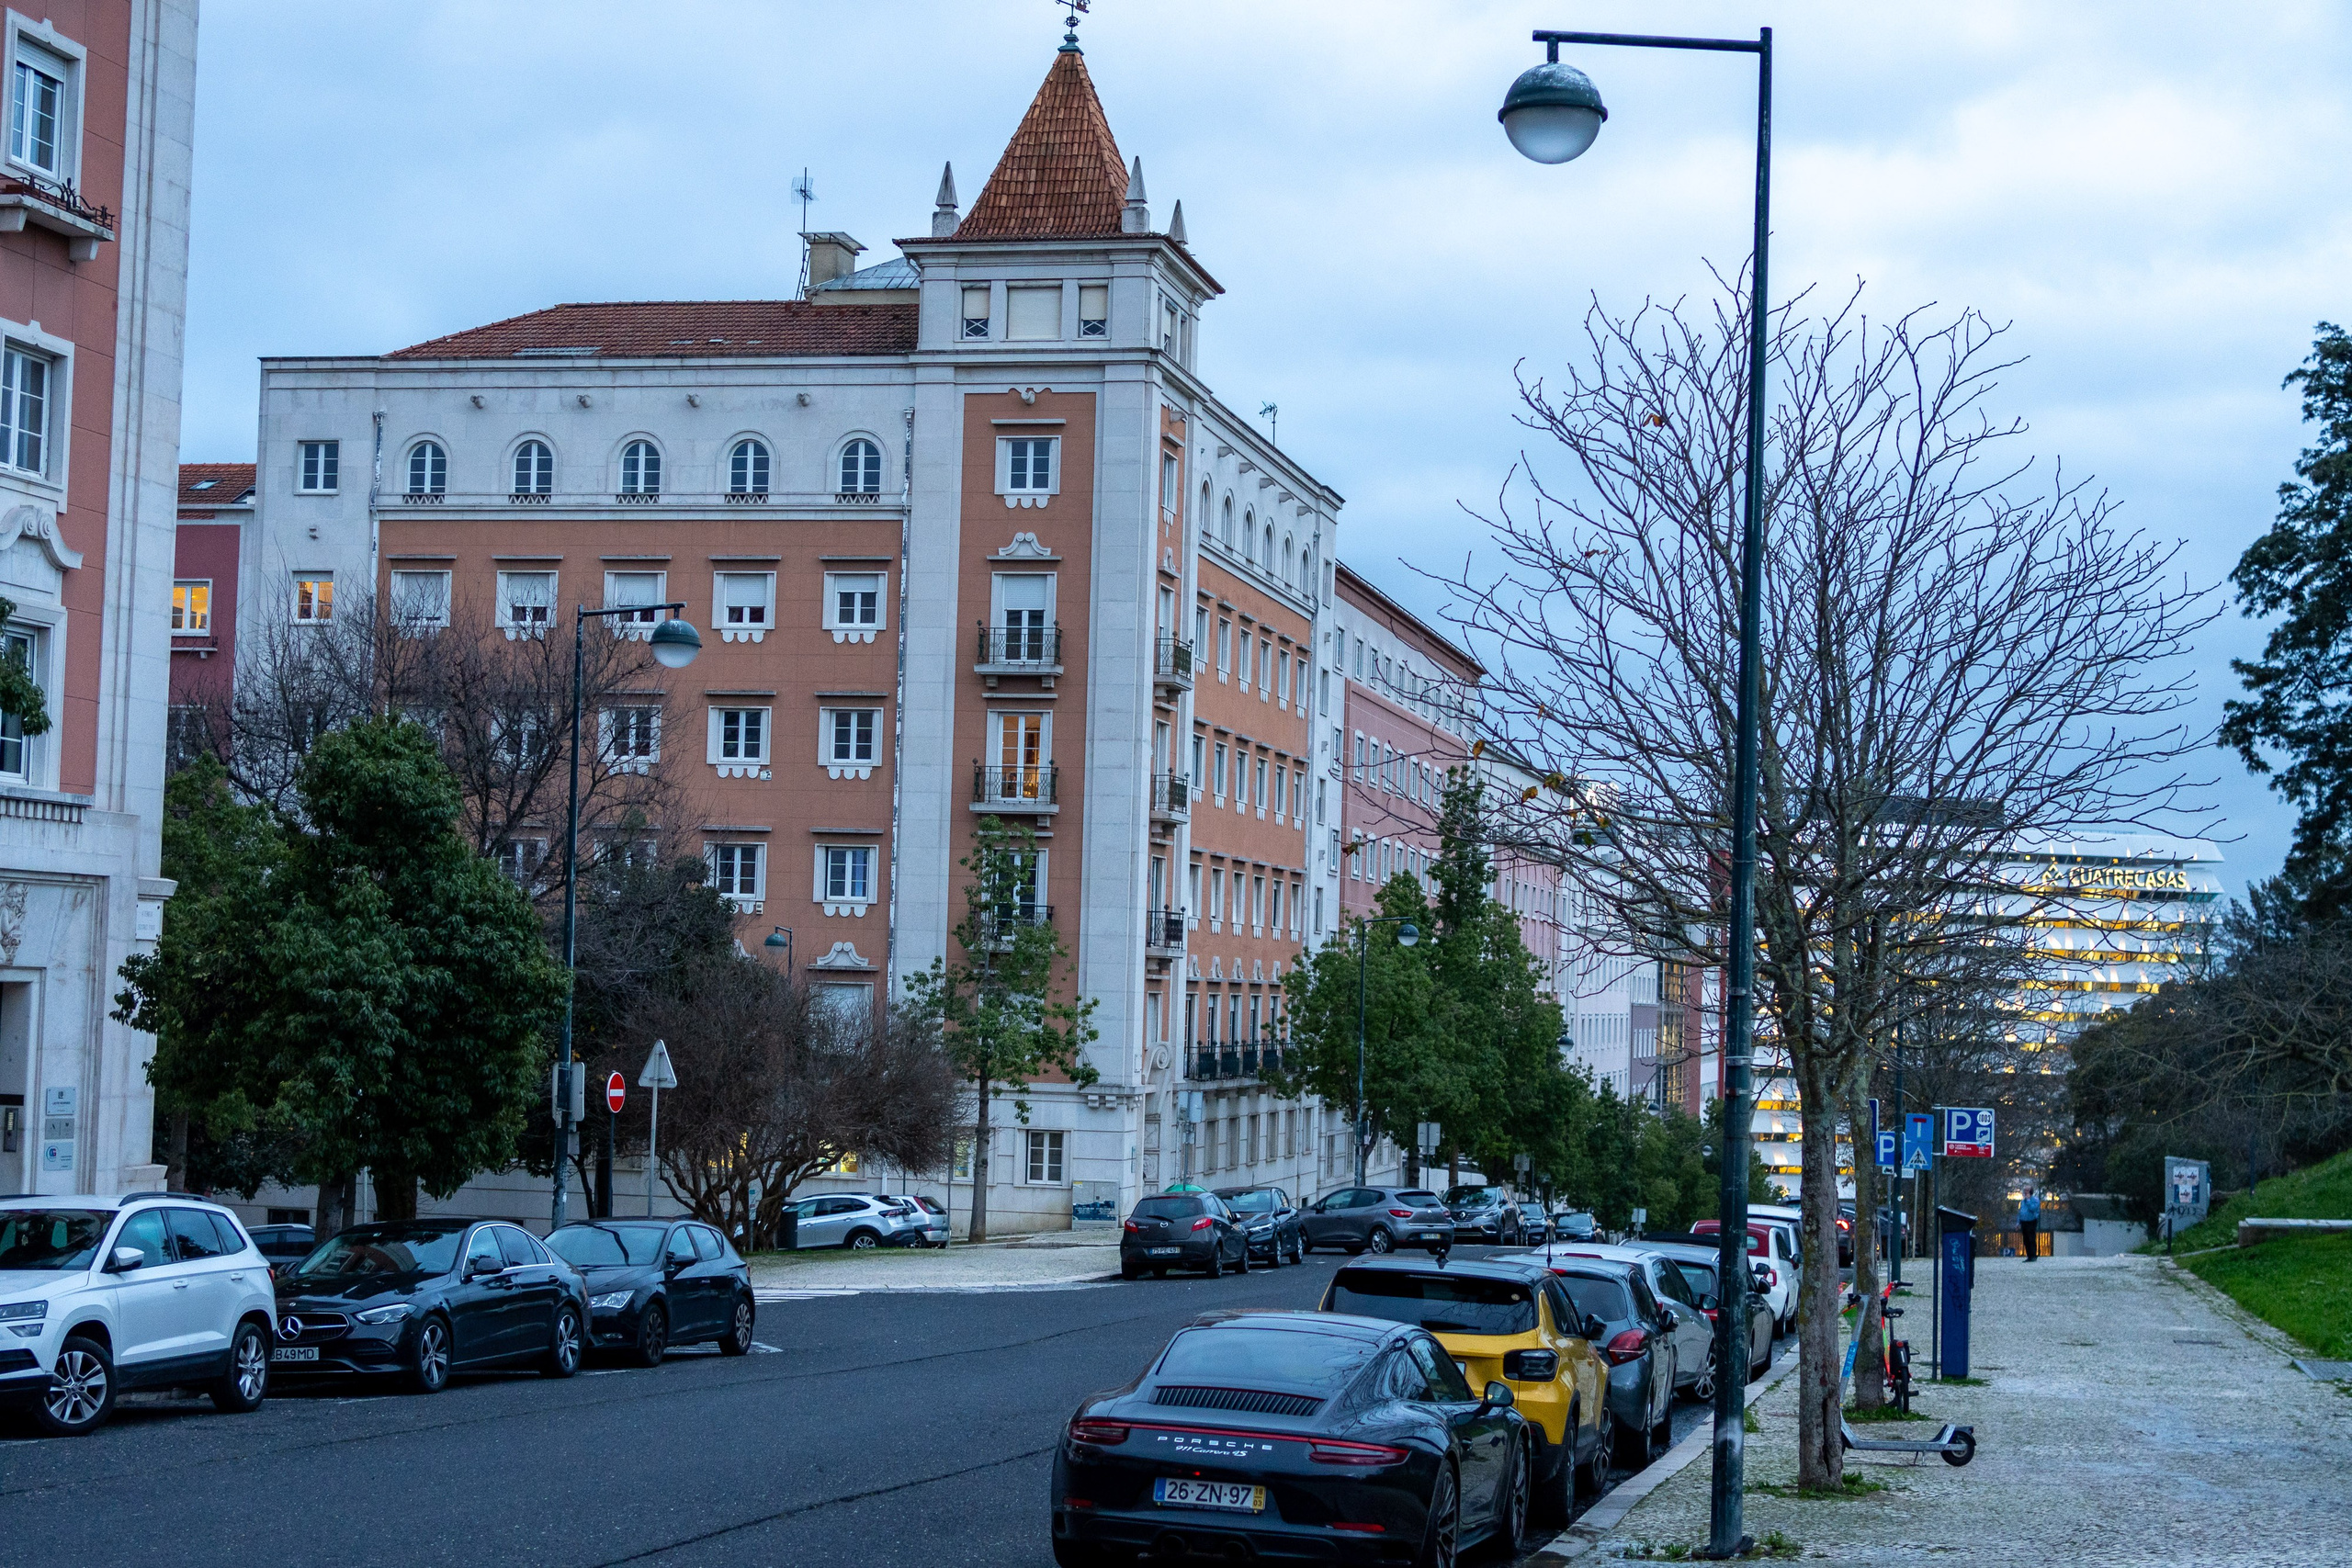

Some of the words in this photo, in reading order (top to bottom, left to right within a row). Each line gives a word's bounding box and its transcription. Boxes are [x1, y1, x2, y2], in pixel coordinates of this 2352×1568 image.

[2069, 866, 2187, 888] CUATRECASAS
[1951, 1111, 1972, 1140] P
[1879, 1134, 1895, 1162] P
[1157, 1436, 1273, 1451] PORSCHE
[1192, 1447, 1231, 1456] Carrera
[1231, 1450, 1249, 1458] 4S
[1253, 1499, 1263, 1507] 03
